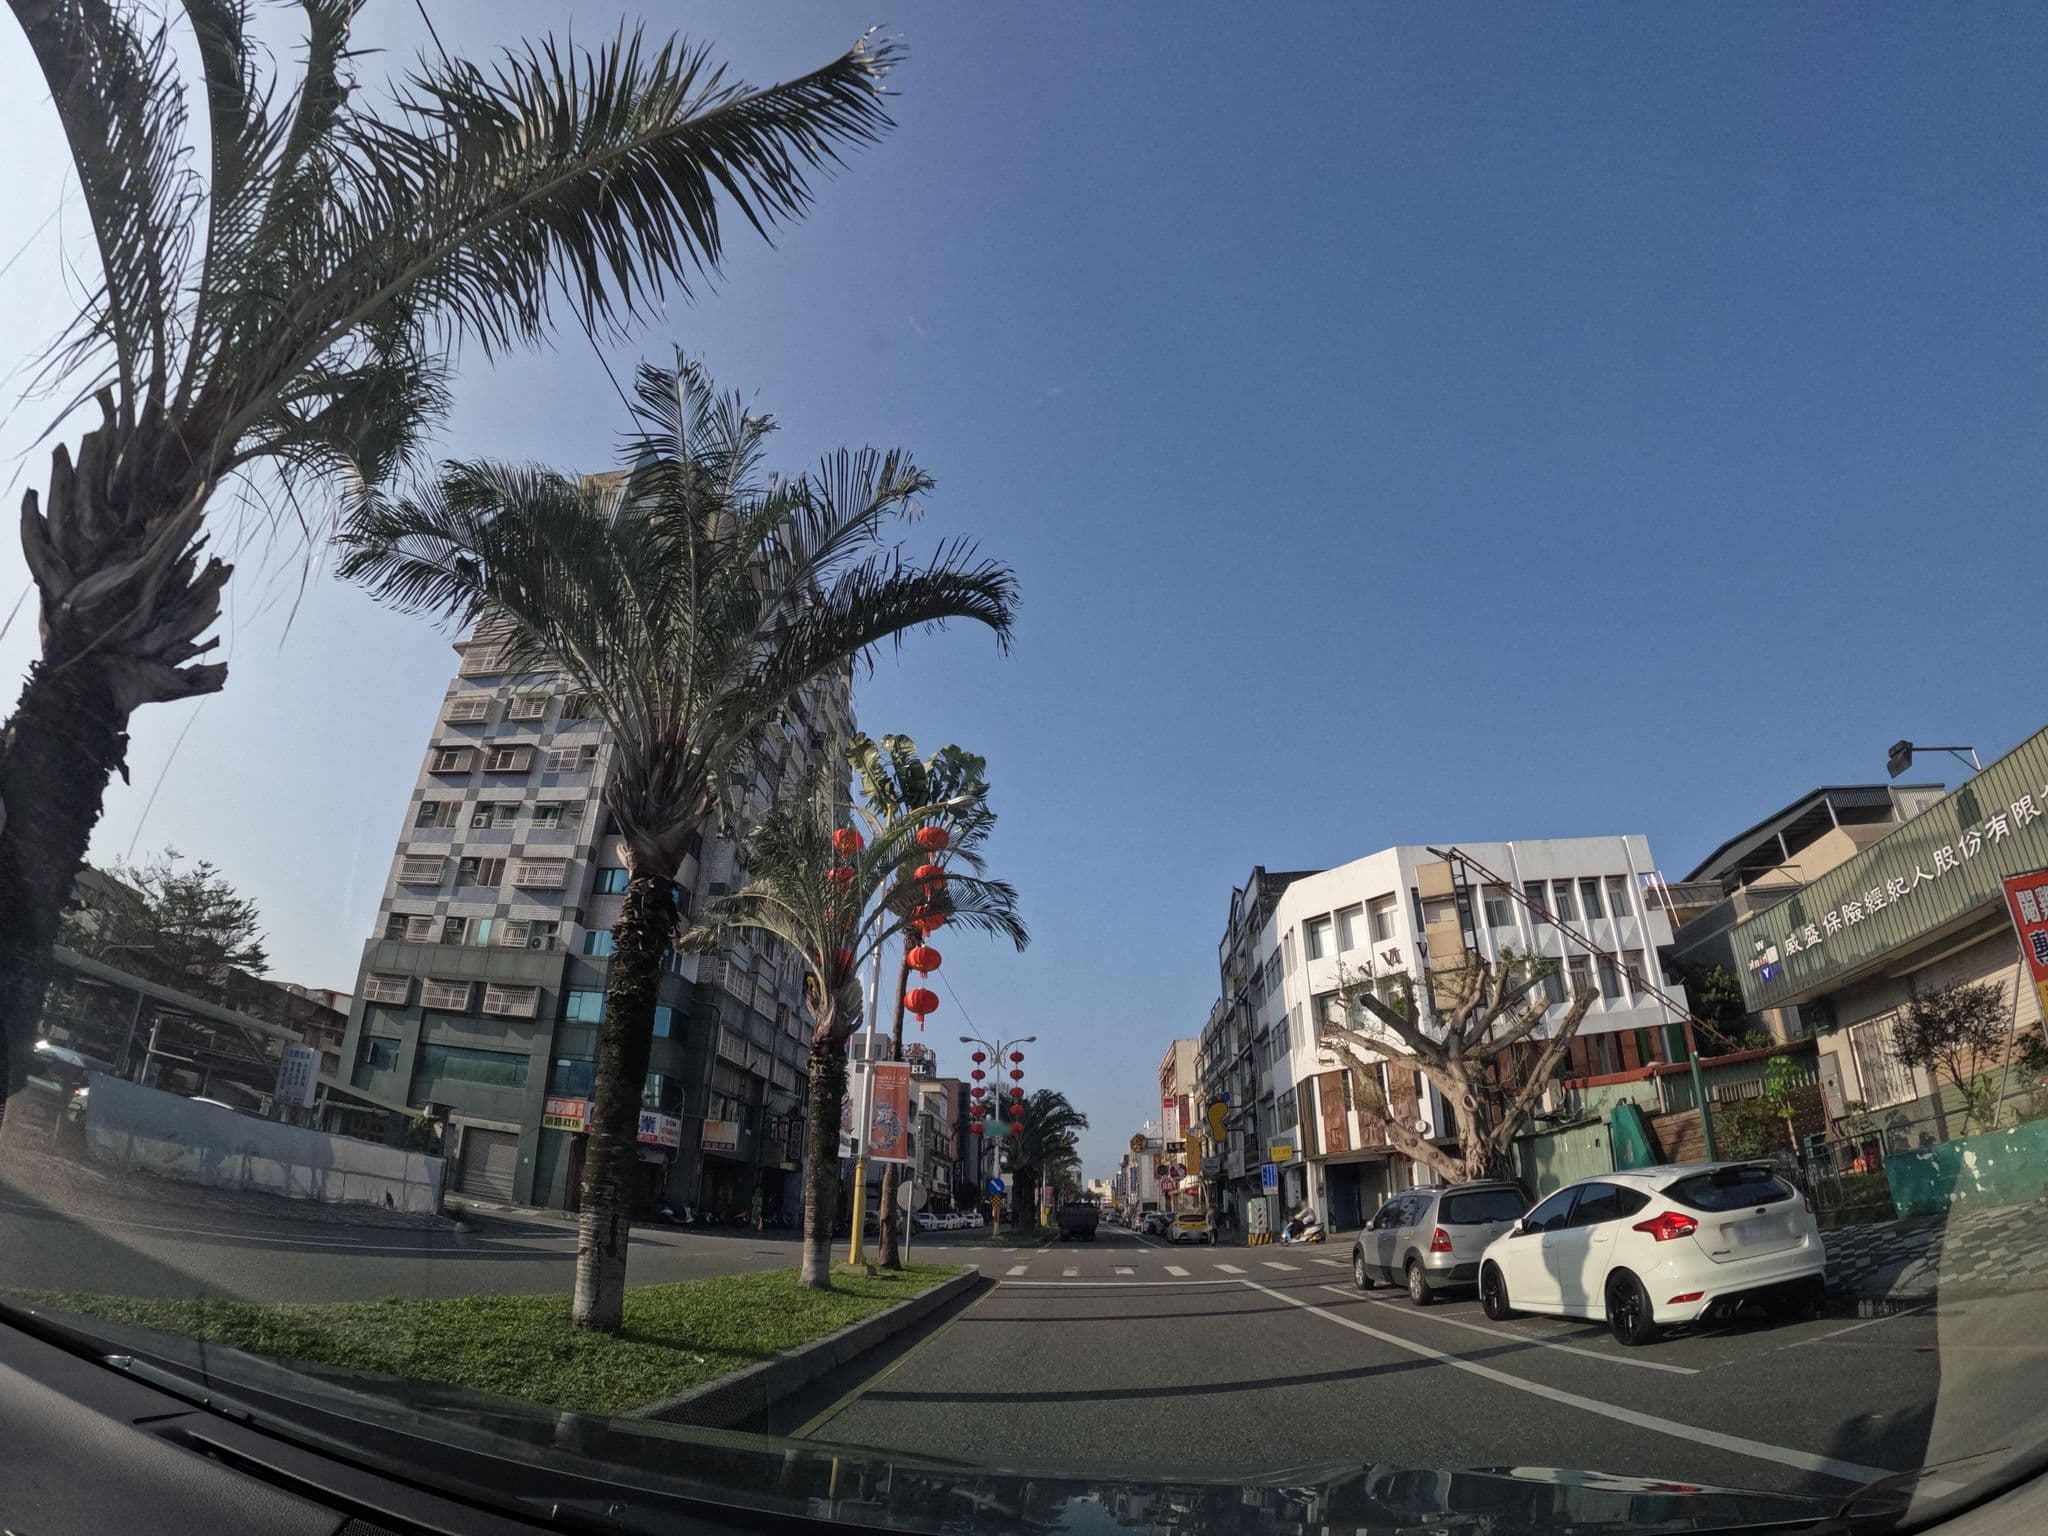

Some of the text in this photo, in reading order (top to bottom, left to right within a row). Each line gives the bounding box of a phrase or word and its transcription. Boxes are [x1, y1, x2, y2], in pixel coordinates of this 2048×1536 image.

[1784, 785, 2048, 957] 威盛保險經紀人股份有限
